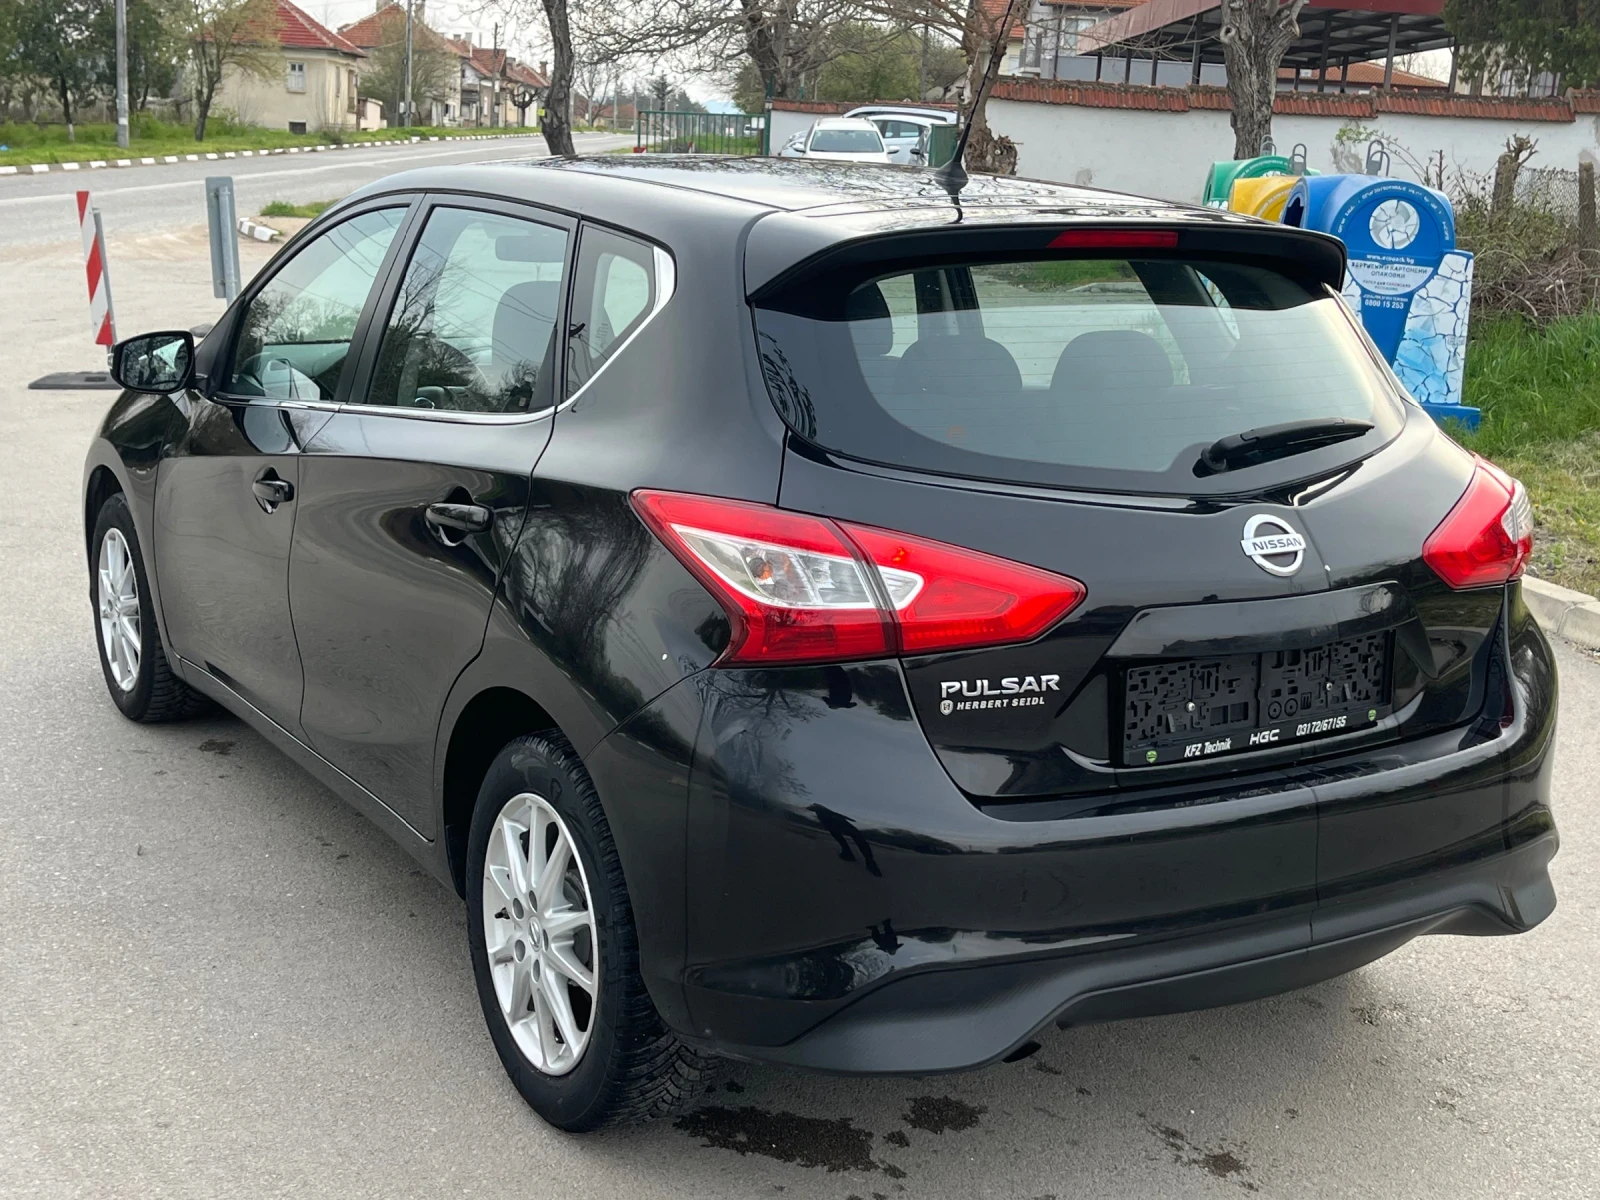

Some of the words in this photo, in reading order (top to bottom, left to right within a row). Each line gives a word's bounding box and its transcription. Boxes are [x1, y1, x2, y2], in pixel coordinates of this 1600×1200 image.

[1383, 300, 1391, 308] 15
[1392, 301, 1404, 309] 253
[1252, 538, 1302, 551] NISSAN
[940, 674, 1060, 698] PULSAR
[957, 699, 1009, 710] HERBERT
[1012, 697, 1045, 706] SEIDL
[1184, 744, 1202, 757] KFZ
[1204, 738, 1231, 754] Technik
[1250, 729, 1280, 745] HGC
[1296, 716, 1347, 736] 03172/67155
